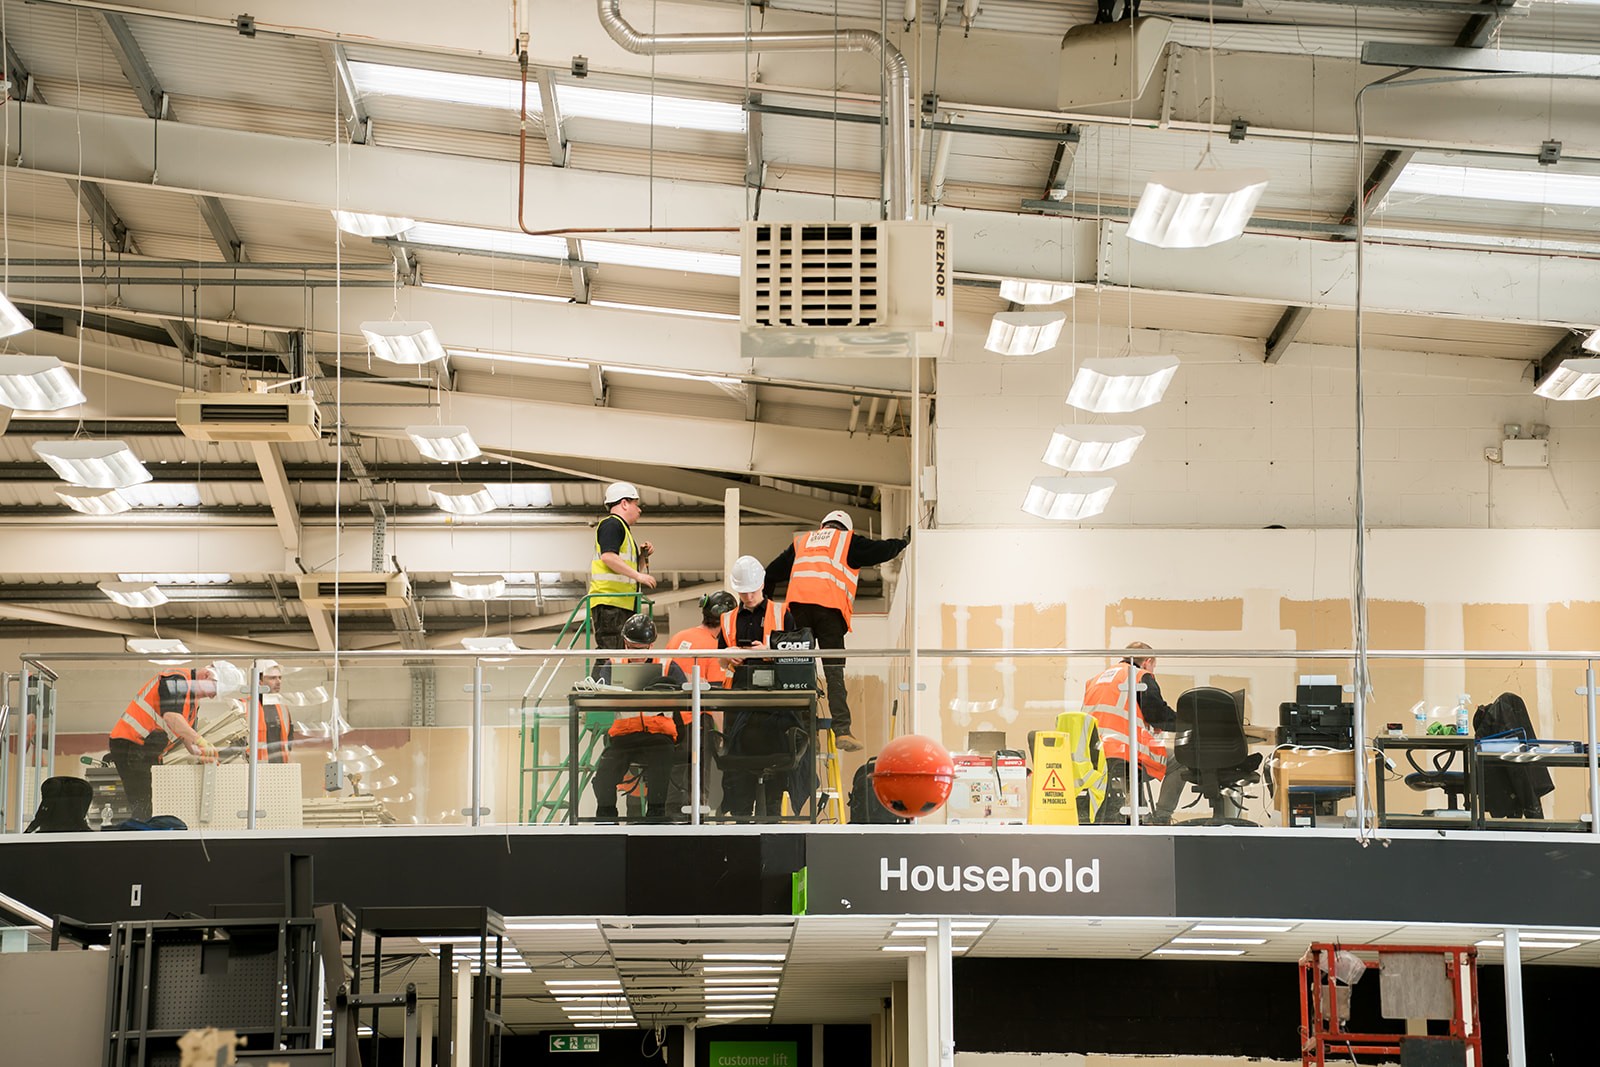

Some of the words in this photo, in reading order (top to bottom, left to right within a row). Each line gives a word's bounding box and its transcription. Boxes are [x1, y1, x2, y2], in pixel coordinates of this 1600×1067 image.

[936, 229, 945, 296] REZNOR
[880, 857, 1100, 893] Household
[718, 1056, 770, 1066] customer
[773, 1053, 788, 1066] lift
